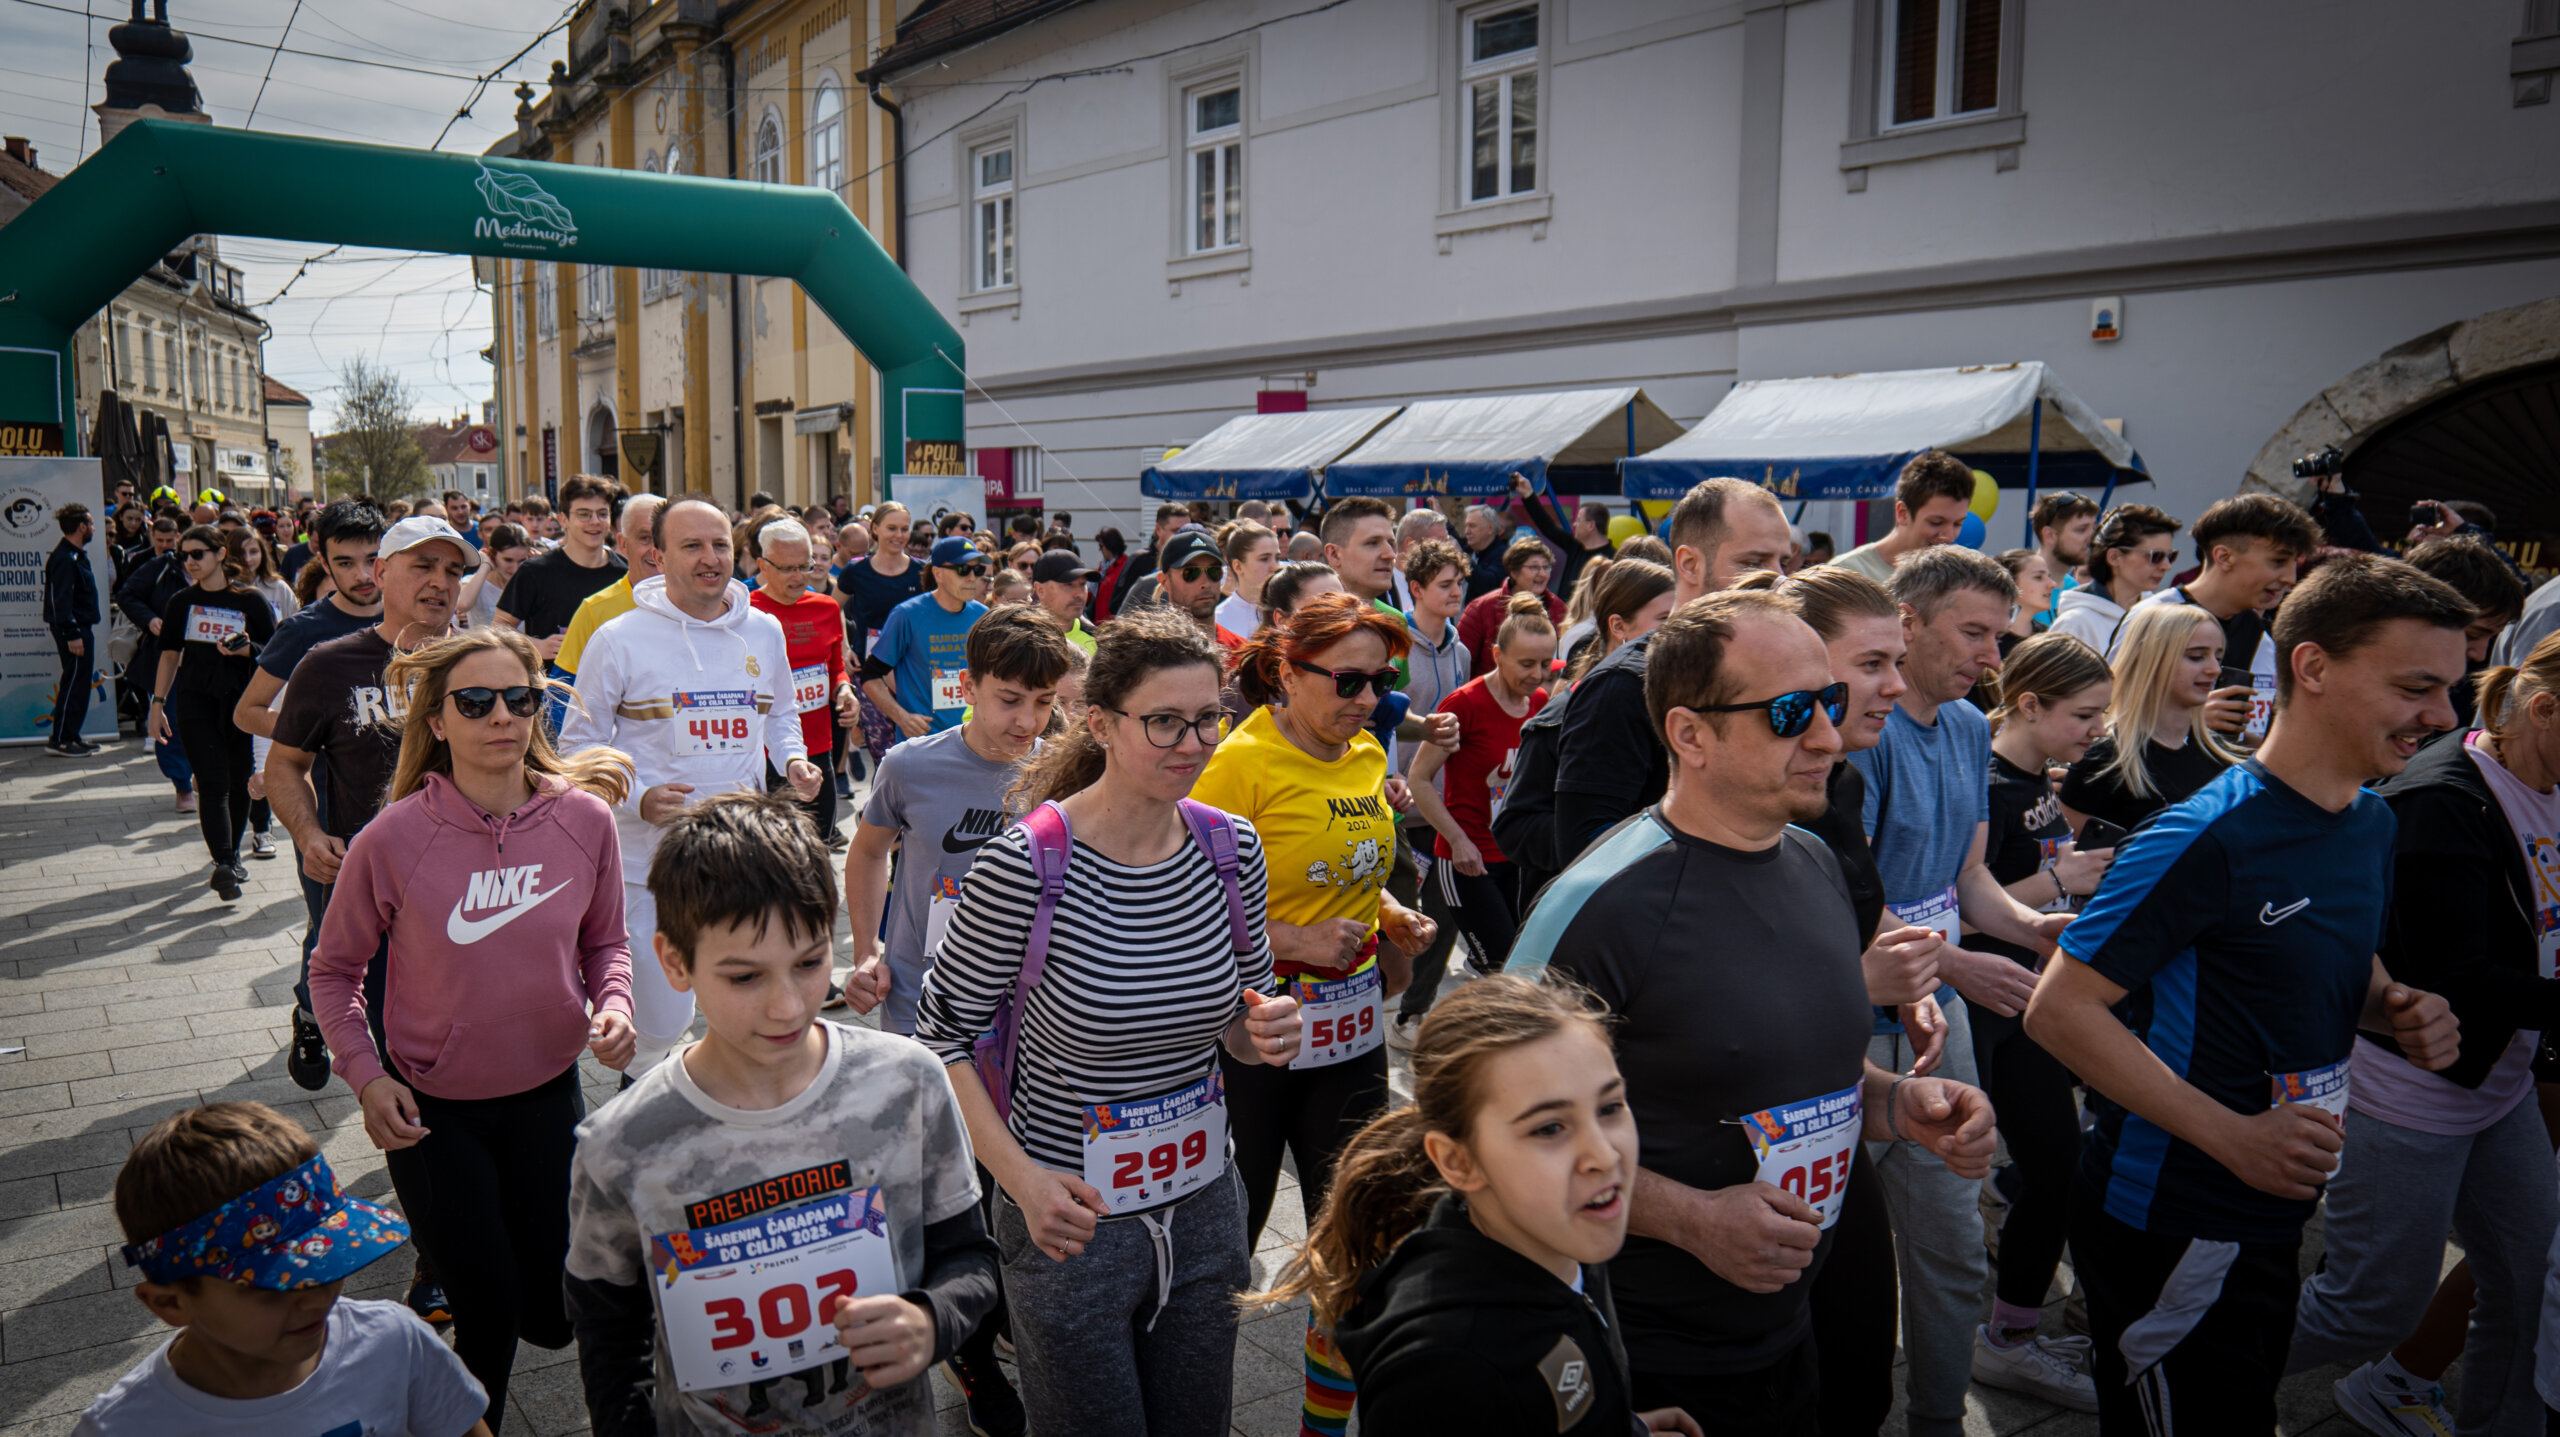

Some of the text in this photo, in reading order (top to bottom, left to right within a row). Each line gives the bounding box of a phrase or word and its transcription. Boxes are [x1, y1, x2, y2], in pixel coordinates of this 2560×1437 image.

[0, 427, 43, 450] OLU
[924, 444, 957, 461] POLU
[908, 461, 965, 475] MARATON
[985, 480, 1004, 496] IPA
[1823, 486, 1851, 495] GRAD
[0, 551, 42, 567] DRUGA
[0, 570, 36, 586] DROM
[1, 590, 36, 602] MURSKE
[198, 621, 235, 636] 055
[929, 634, 967, 643] EUROP
[930, 644, 967, 653] MARAT
[943, 686, 964, 699] 43
[355, 683, 416, 726] RE
[689, 718, 748, 740] 448
[1327, 795, 1386, 823] KALNIK
[1346, 819, 1371, 832] 2021
[463, 863, 543, 912] NIKE
[1326, 993, 1335, 1001] DO
[1311, 1005, 1374, 1048] 569
[1120, 1103, 1160, 1119] ŠARENIM
[1162, 1084, 1206, 1109] ČARAPAMA
[1130, 1117, 1144, 1128] DO
[1148, 1110, 1174, 1126] CILJA
[1792, 1121, 1806, 1137] DO
[1113, 1129, 1207, 1189] 299
[1780, 1147, 1850, 1204] 053
[693, 1163, 846, 1228] PREHISTORIC
[705, 1203, 846, 1250] ŠARENIM ČARAPAMA
[720, 1246, 740, 1263] DO
[746, 1237, 787, 1258] CILJA
[792, 1224, 832, 1245] 2025.
[705, 1268, 858, 1351] 302
